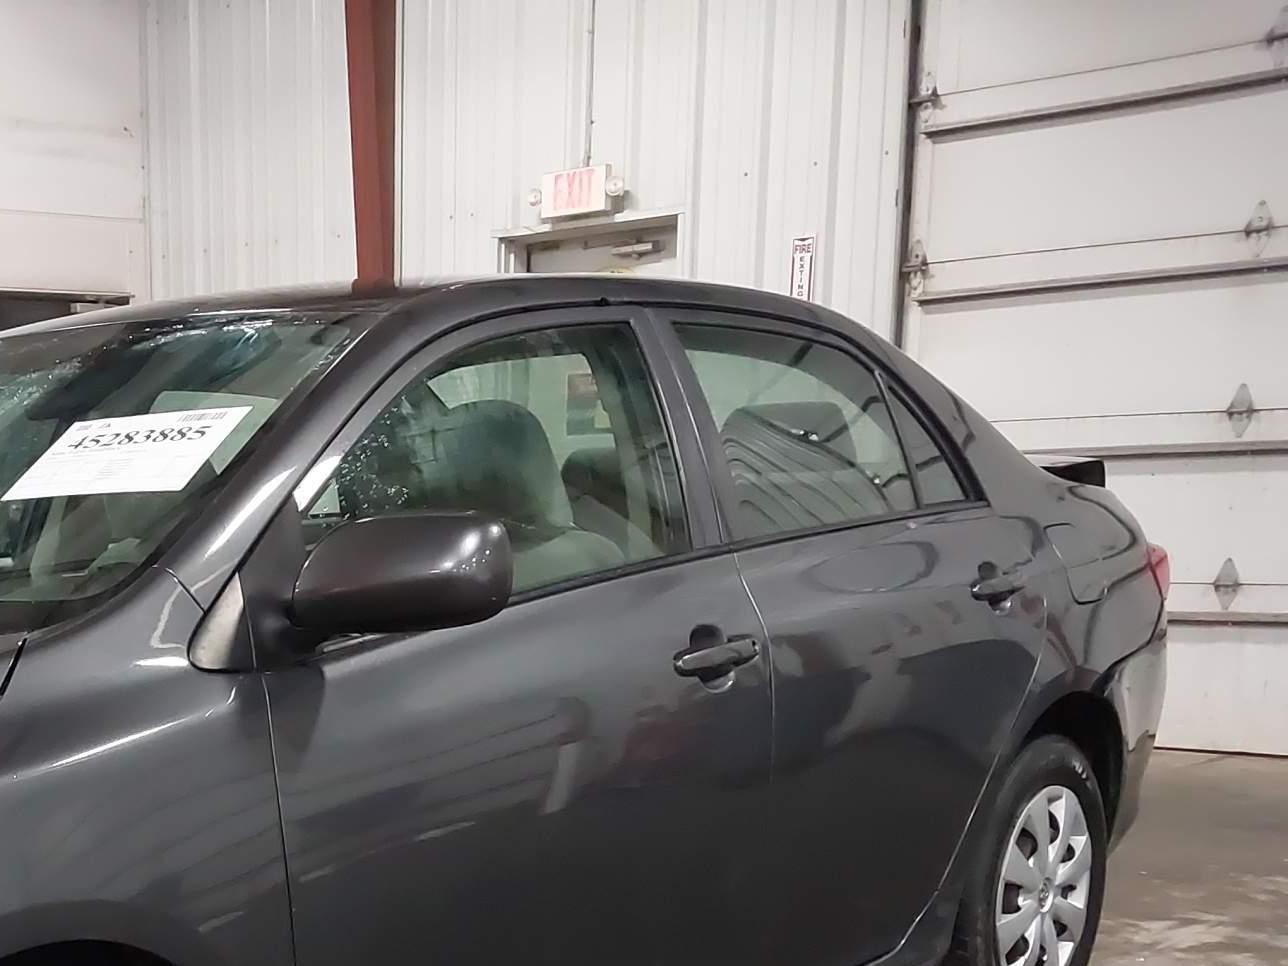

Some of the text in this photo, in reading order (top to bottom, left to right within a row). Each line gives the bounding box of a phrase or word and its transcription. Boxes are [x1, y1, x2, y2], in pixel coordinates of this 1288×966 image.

[553, 168, 595, 211] EXIT
[794, 243, 812, 254] FIRE
[68, 425, 212, 450] 45283885
